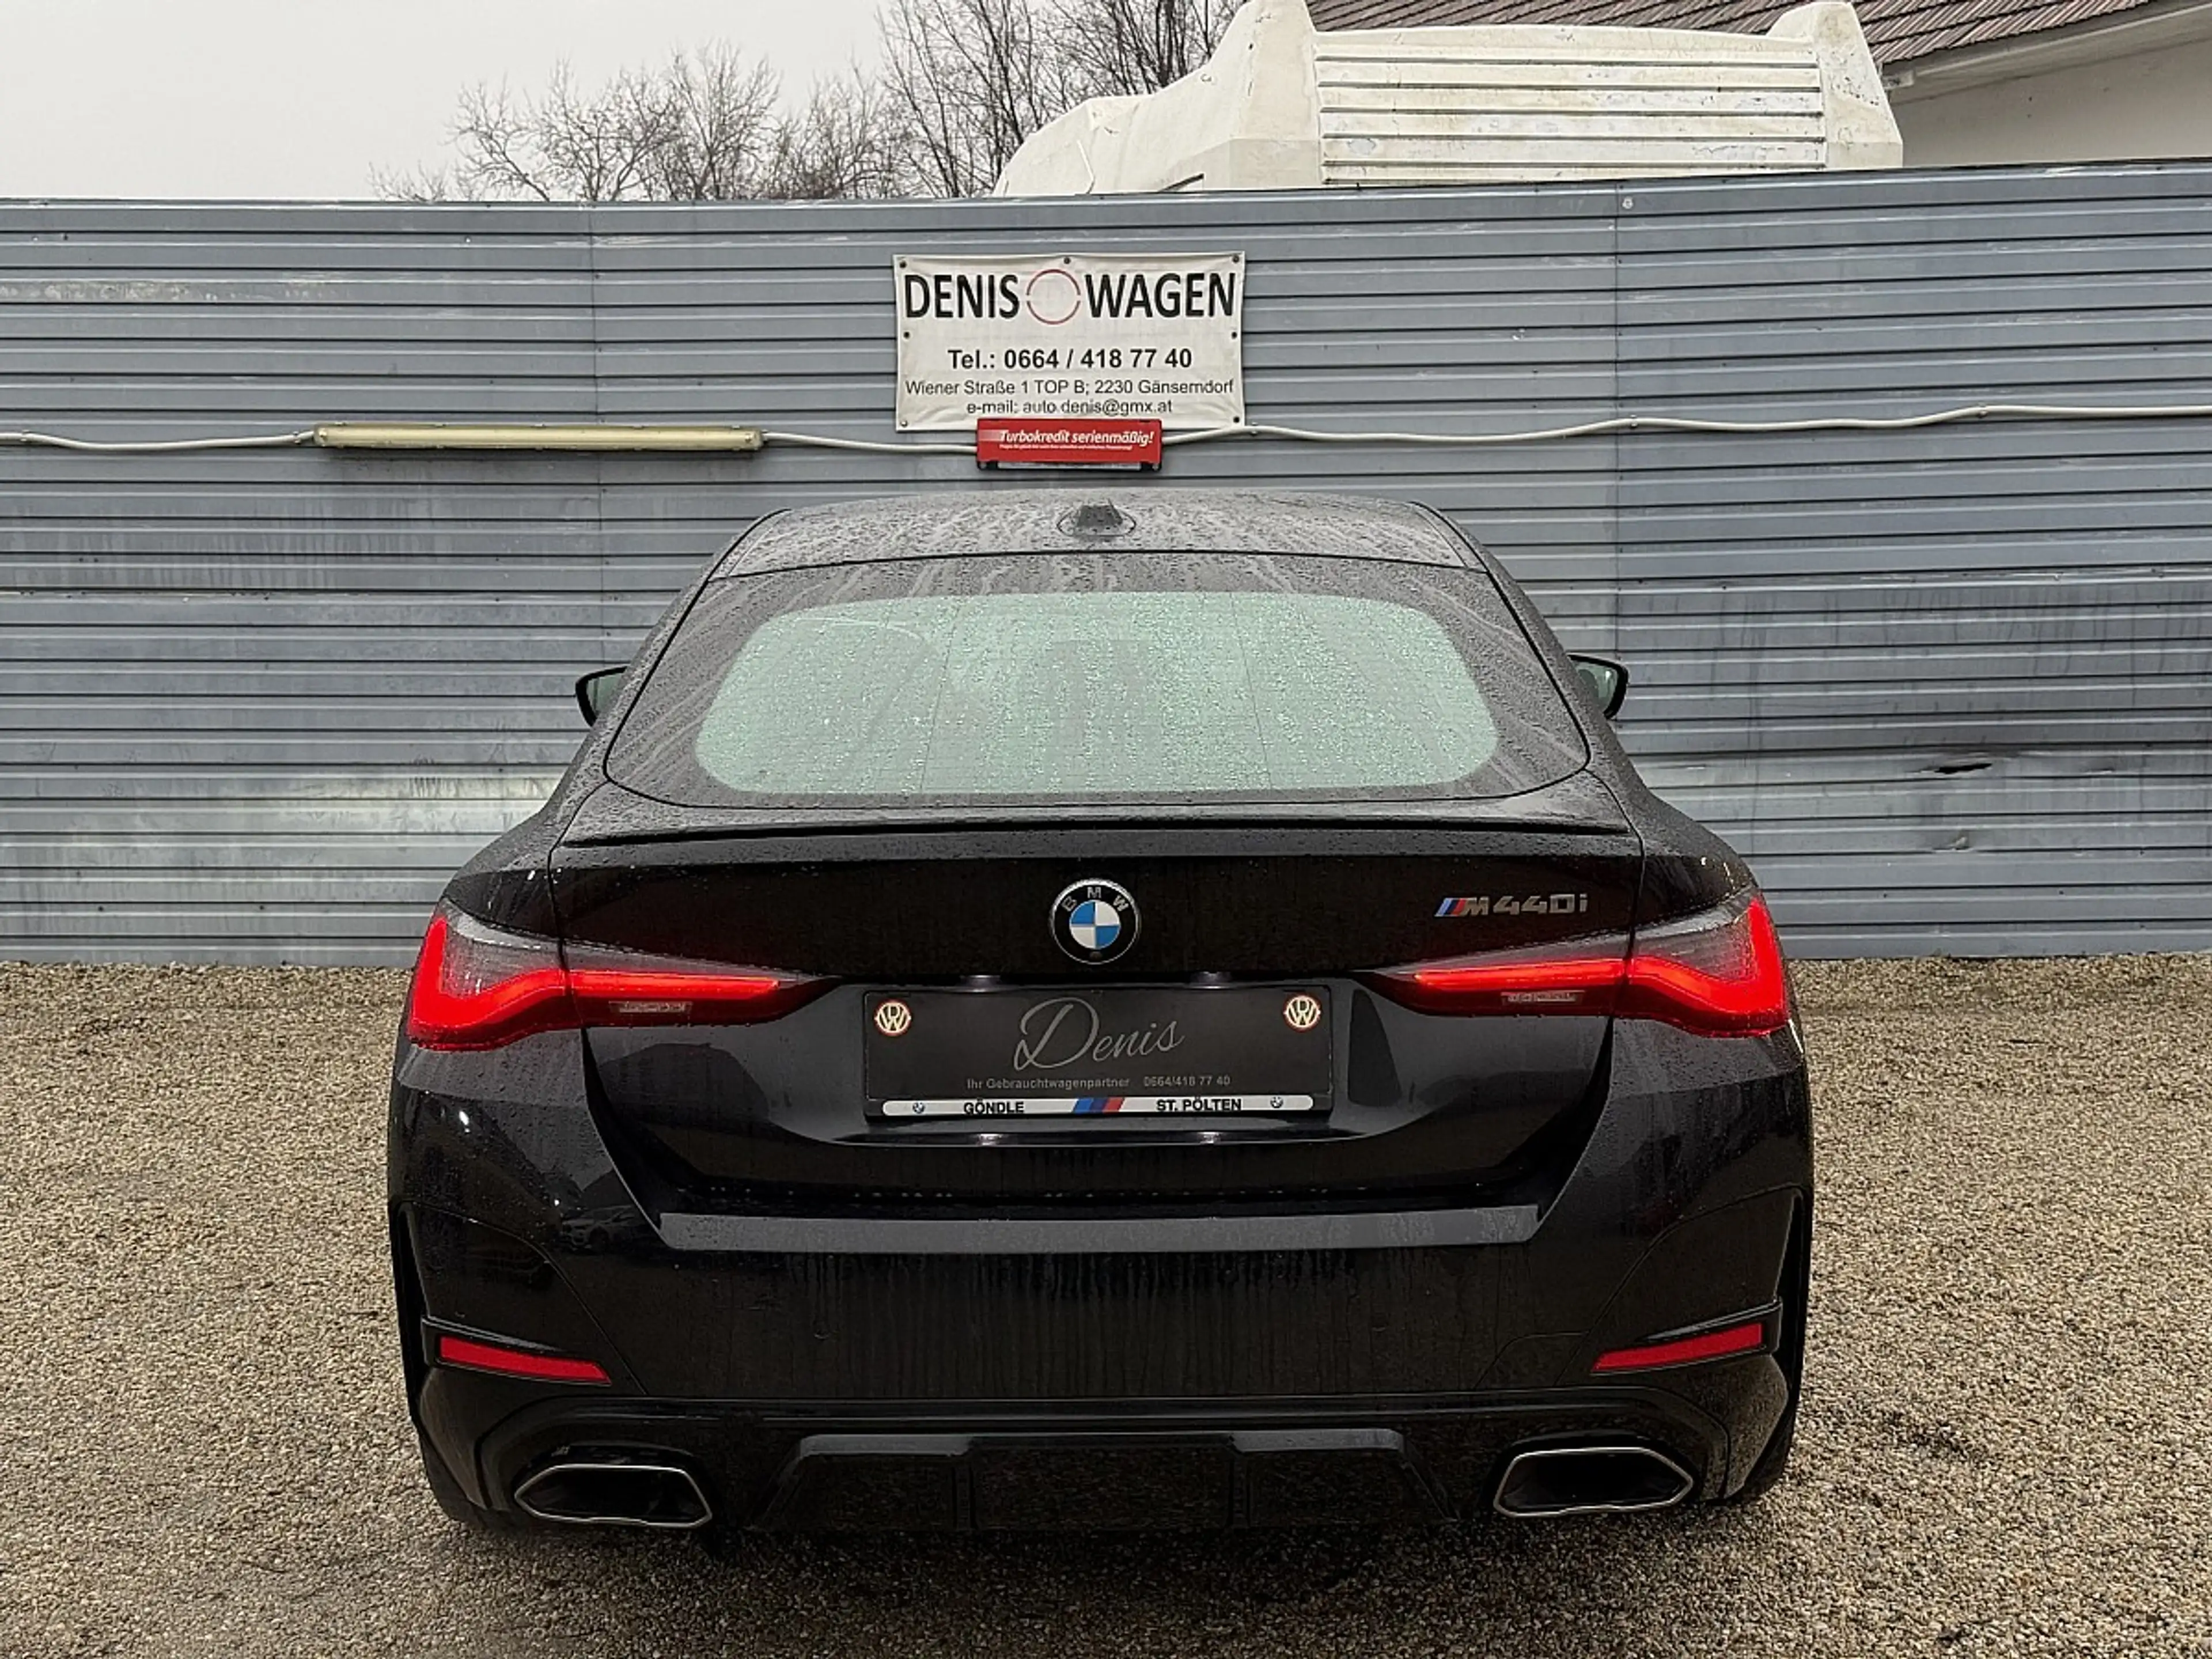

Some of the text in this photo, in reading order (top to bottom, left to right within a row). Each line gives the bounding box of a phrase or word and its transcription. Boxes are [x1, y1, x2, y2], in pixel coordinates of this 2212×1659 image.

[904, 272, 1236, 318] DENIS WAGEN
[948, 348, 1192, 369] Tel.: 0664 / 418 77 40
[905, 380, 960, 395] Wiener
[964, 380, 1015, 395] Straße
[1021, 380, 1028, 393] 1
[1035, 380, 1069, 394] TOP
[1074, 380, 1089, 395] B;
[1094, 380, 1132, 394] 2230
[967, 400, 1018, 414] e-mail:
[998, 429, 1154, 447] Turbokredit serienmäßig!
[1061, 887, 1129, 912] BMW
[1014, 997, 1185, 1071] Denis
[967, 1077, 1130, 1090] Ihr Gebrauchtwagenpartner
[1199, 1075, 1213, 1086] 77
[1217, 1075, 1230, 1086] 40
[964, 1097, 1024, 1114] GÖNDLE
[1156, 1096, 1242, 1111] ST. PÖLTEN
